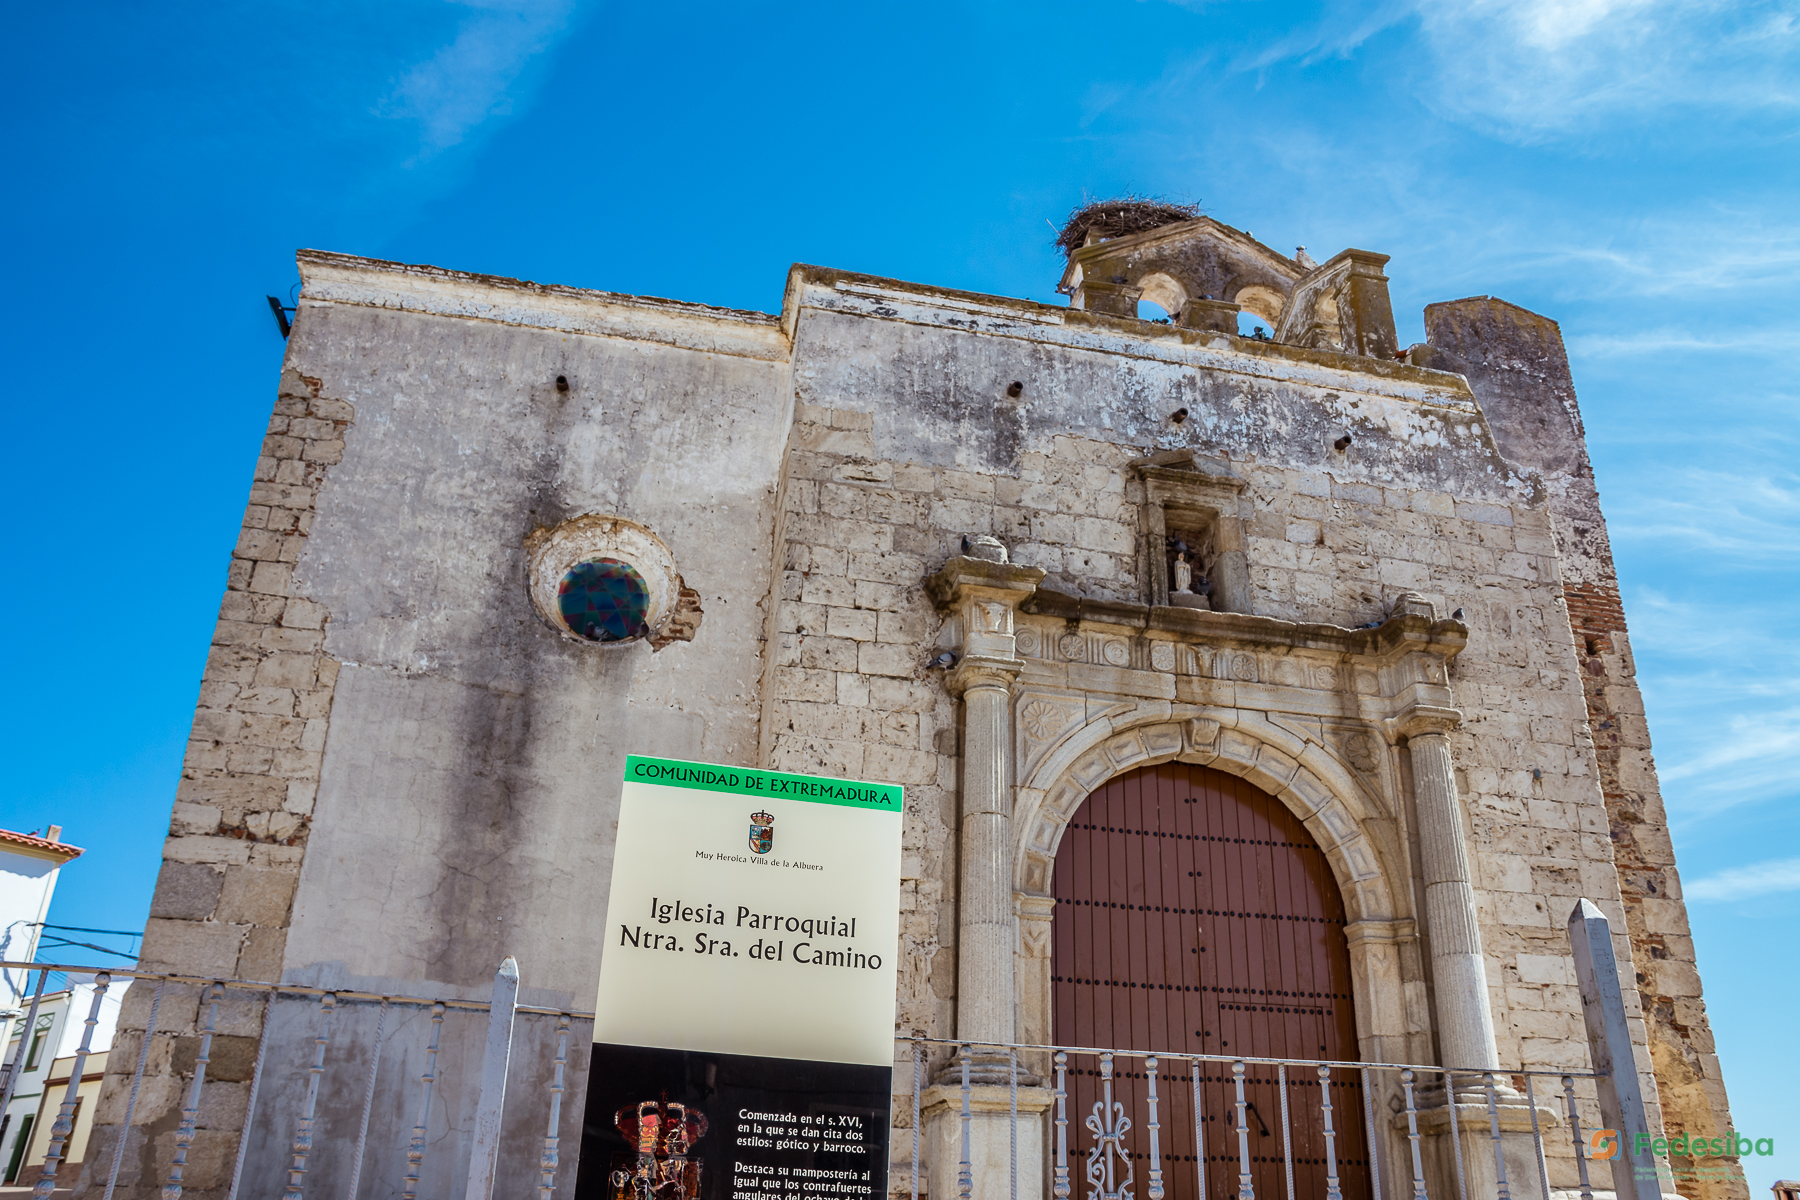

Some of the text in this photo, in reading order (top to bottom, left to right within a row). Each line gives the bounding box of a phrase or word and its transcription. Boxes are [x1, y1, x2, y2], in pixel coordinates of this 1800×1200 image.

[635, 764, 891, 804] COMUNIDAD DE EXTREMADURA
[696, 851, 713, 860] Muy
[717, 853, 746, 863] Heroica
[750, 857, 767, 865] Villa
[793, 862, 823, 871] Albuera
[651, 897, 856, 938] Iglesia Parroquial
[620, 925, 882, 969] Ntra. Sra. del Camino
[739, 1109, 862, 1128] Comenzada en el s. XVI,
[738, 1123, 863, 1140] en la que se dan cita dos
[737, 1136, 866, 1154] estilos: gótico y barroco.
[735, 1162, 870, 1180] Destaca su mampostería al
[734, 1176, 871, 1194] igual que los contrafuertes
[733, 1191, 781, 1200] angulares
